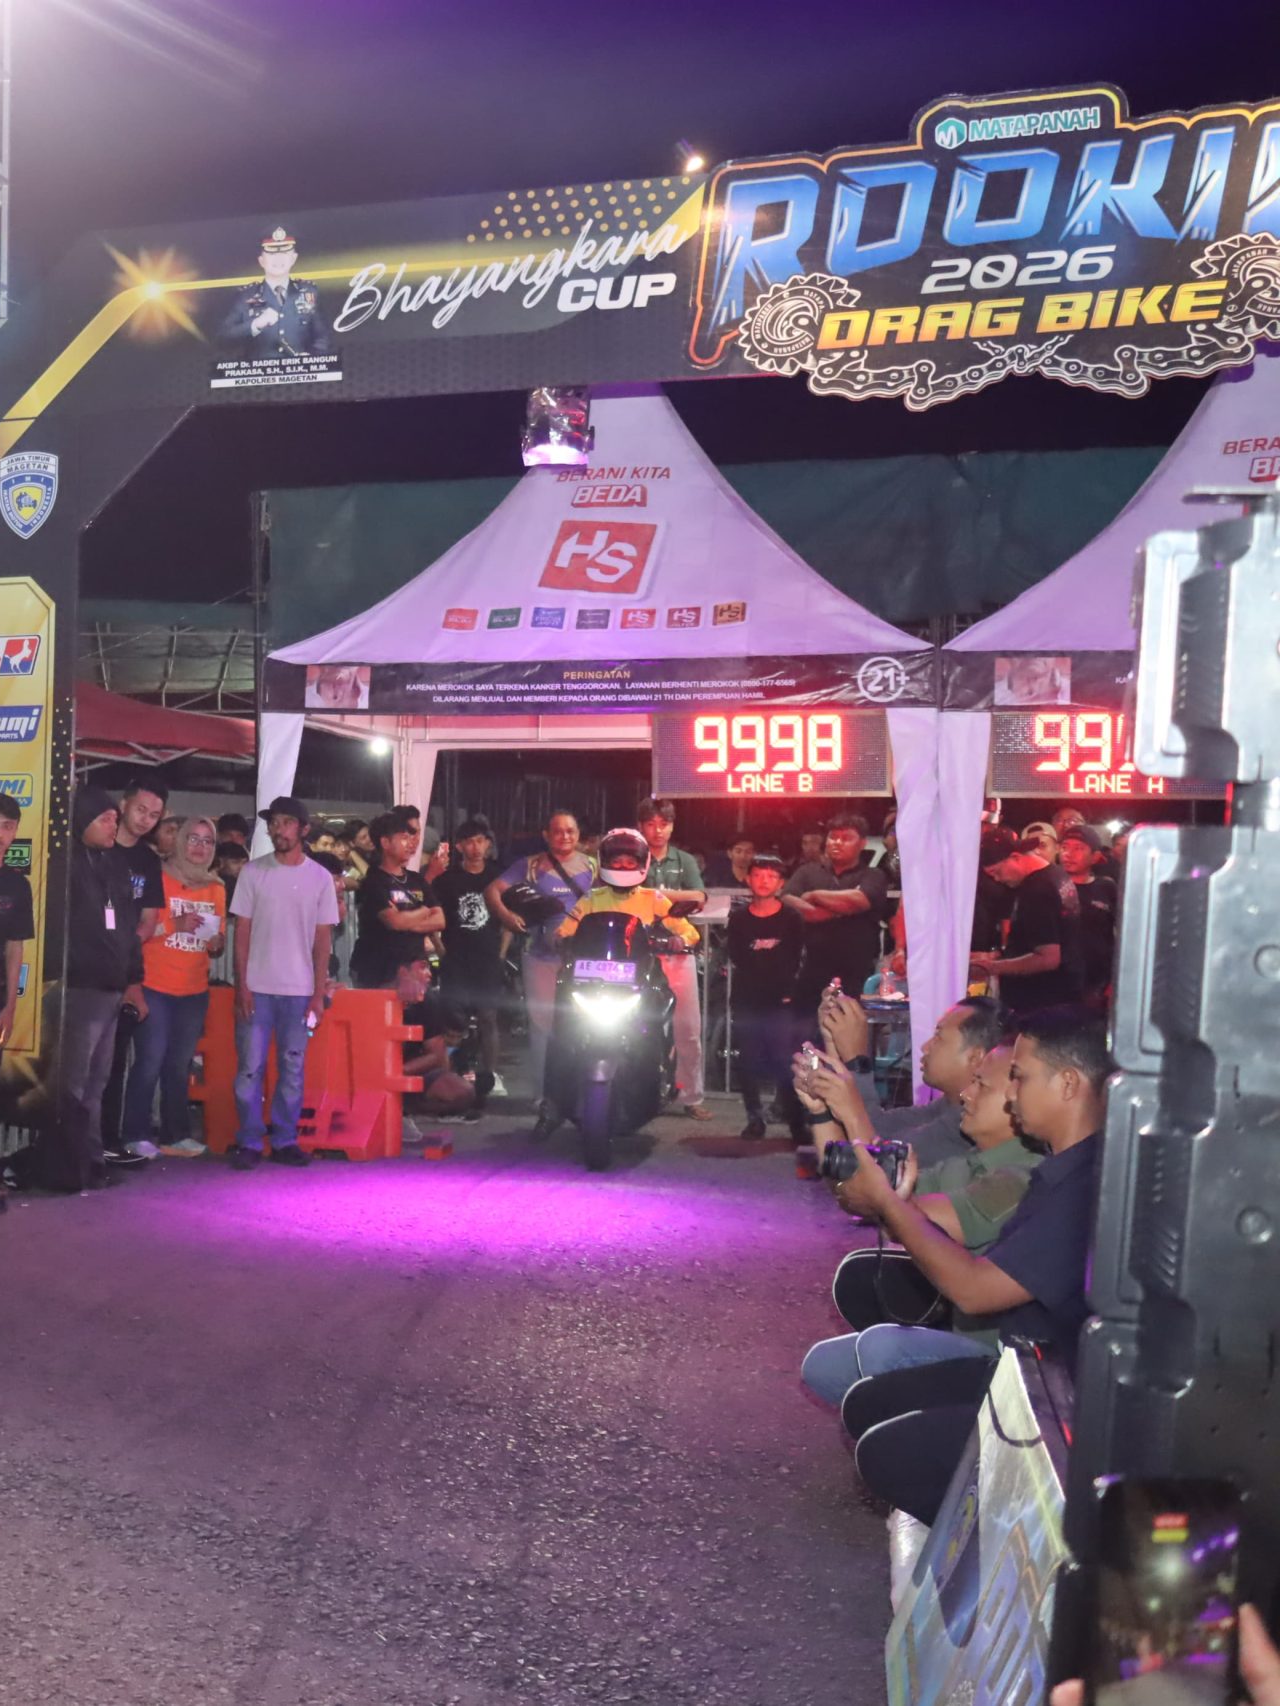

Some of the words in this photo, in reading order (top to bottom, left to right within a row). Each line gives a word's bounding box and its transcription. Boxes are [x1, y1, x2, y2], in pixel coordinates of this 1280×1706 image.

[968, 107, 1101, 142] MATAPANAH
[333, 218, 689, 332] Bhayangkara
[920, 244, 1116, 295] 2026
[557, 272, 677, 313] CUP
[817, 296, 1025, 350] DRAG
[1036, 279, 1228, 333] BIKE
[216, 362, 239, 370] AKBP
[252, 359, 280, 368] RADEN
[281, 358, 301, 366] ERIK
[302, 355, 338, 364] BANGUN
[224, 369, 265, 377] PRAKASA,
[309, 364, 329, 372] M.M.
[234, 377, 277, 386] KAPOLRES
[278, 374, 318, 383] MAGETAN
[7, 456, 26, 465] JAWA
[28, 455, 51, 463] TIMUR
[7, 463, 49, 473] MAGETAN
[556, 466, 628, 482] BERANI
[630, 466, 671, 479] KITA
[571, 484, 648, 508] BEDA
[554, 530, 638, 584] HS
[627, 610, 649, 624] HS
[673, 608, 697, 623] HS
[563, 670, 631, 680] PERINGATAN
[867, 667, 910, 692] 21+
[405, 683, 437, 691] KARENA
[437, 683, 474, 691] MEROKOK
[475, 683, 493, 691] SAYA
[495, 683, 529, 691] TERKENA
[530, 683, 561, 691] KANKER
[625, 681, 661, 690] LAYANAN
[661, 681, 700, 689] BERHENTI
[700, 680, 740, 689] MEROKOK
[432, 695, 470, 703] DILARANG
[471, 695, 505, 703] MENJUAL
[558, 694, 589, 702] KEPADA
[589, 694, 617, 702] ORANG
[653, 693, 662, 701] 21
[663, 693, 674, 701] TH
[675, 693, 692, 701] DAN
[692, 692, 741, 700] PEREMPUAN
[741, 691, 766, 699] HAMIL
[694, 713, 843, 772] 9998
[1034, 713, 1136, 772] 99
[727, 774, 785, 793] LANE
[798, 773, 814, 792] B
[1069, 773, 1132, 793] LANE
